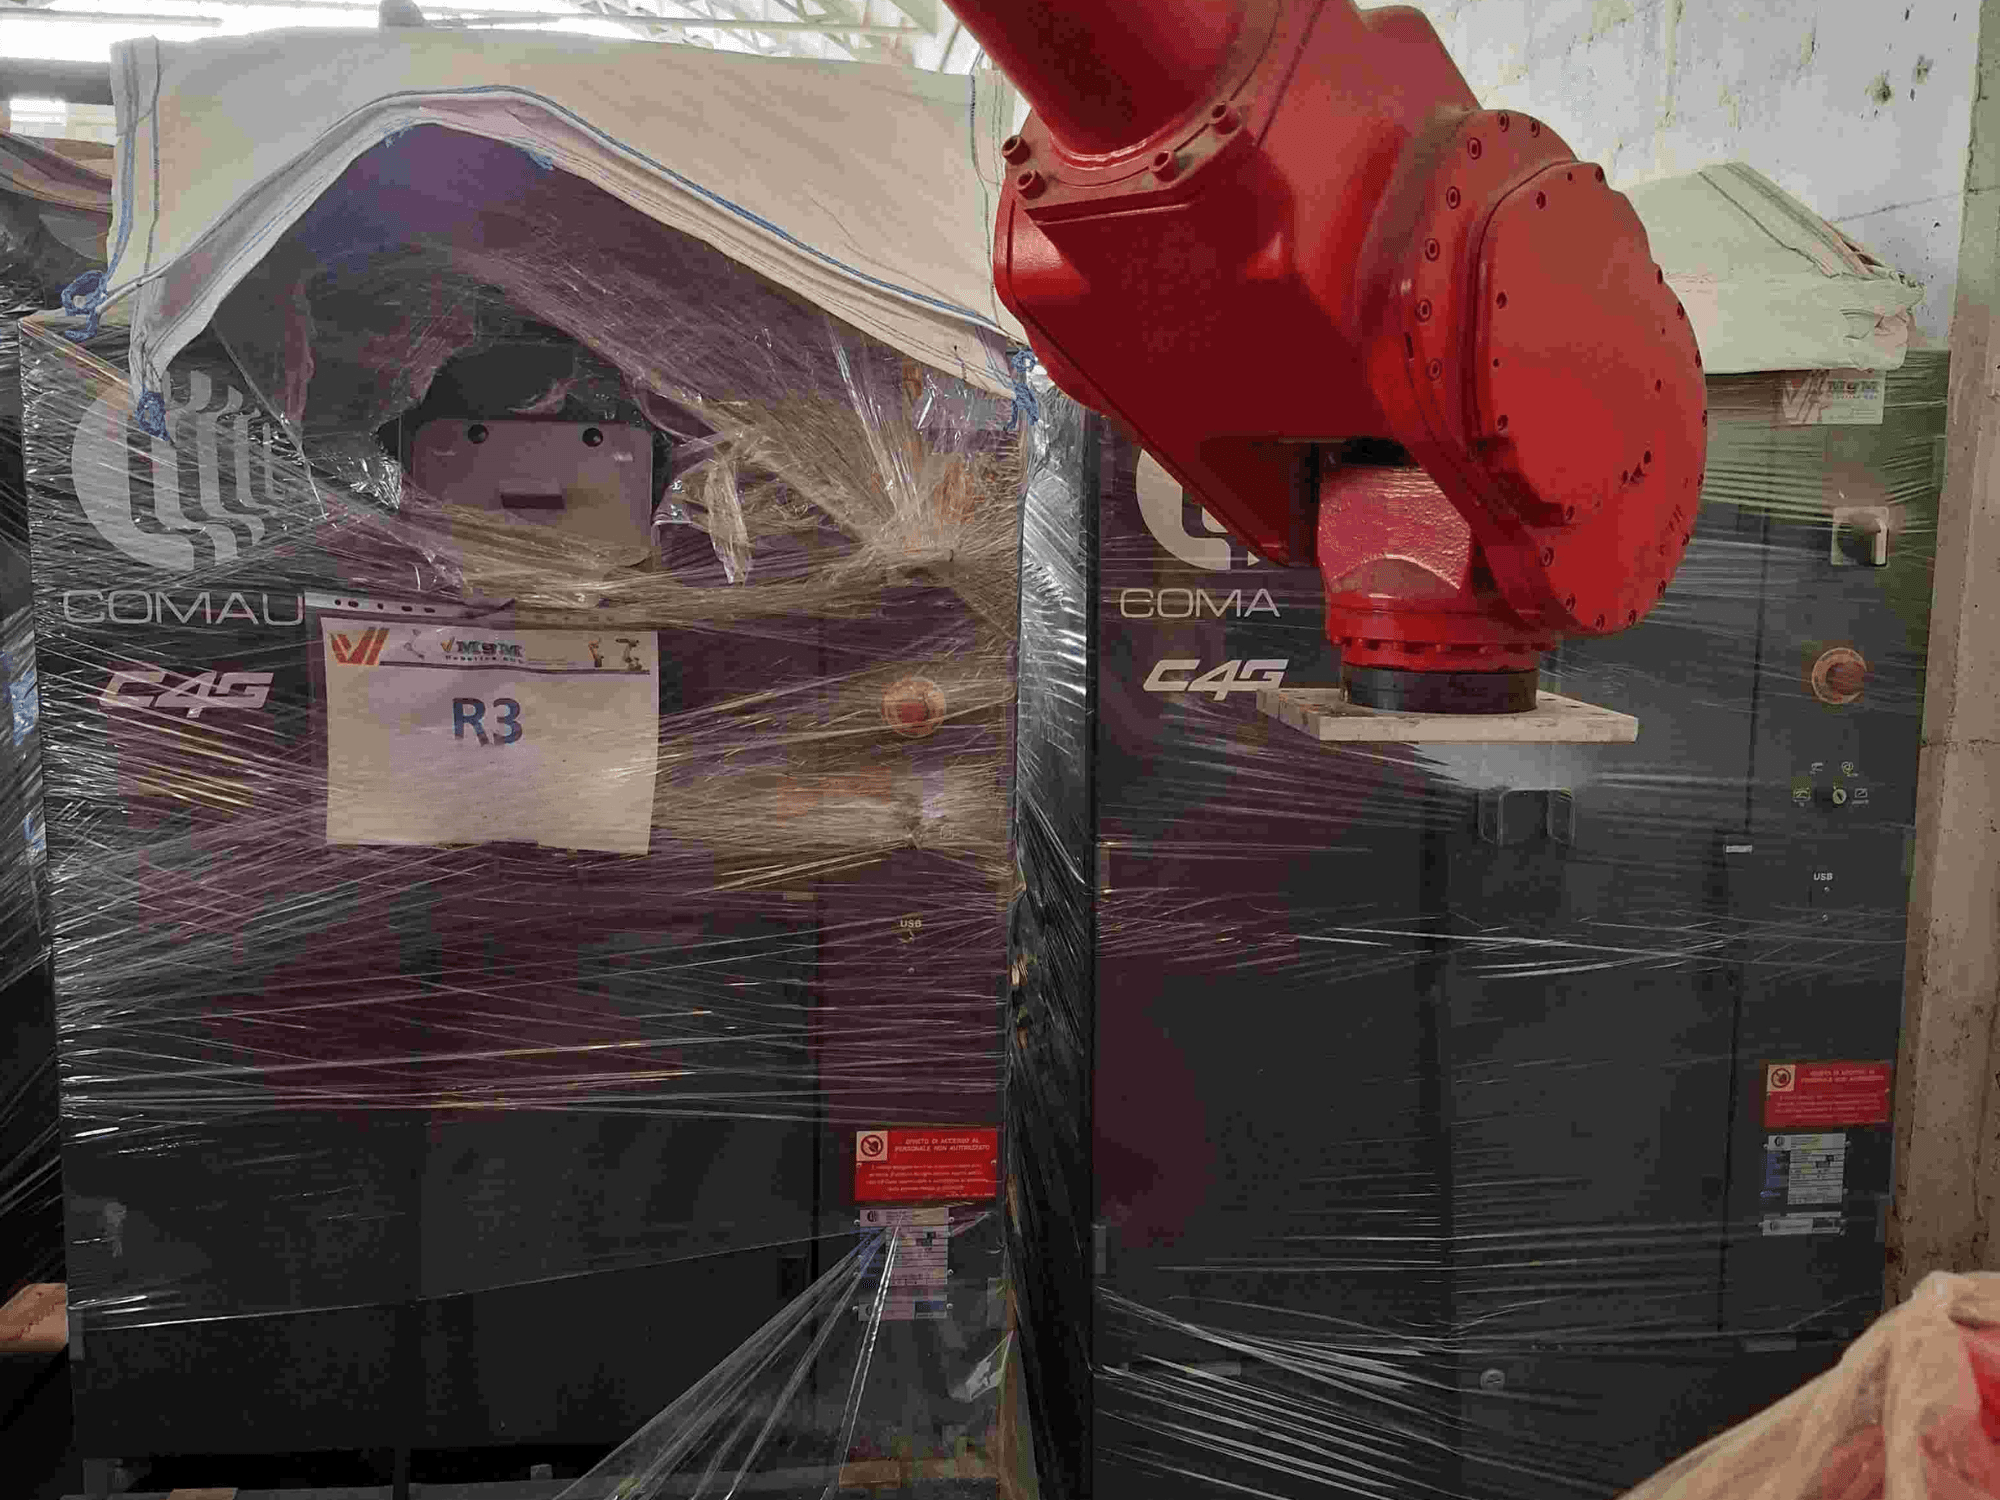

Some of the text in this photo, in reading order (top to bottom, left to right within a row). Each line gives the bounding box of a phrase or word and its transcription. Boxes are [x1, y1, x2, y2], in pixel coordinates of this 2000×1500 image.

[63, 589, 304, 626] COMAU
[1120, 588, 1281, 618] COMA
[100, 671, 274, 718] C4G
[1143, 659, 1289, 700] C4G
[452, 697, 523, 746] R3
[1813, 872, 1833, 881] USB
[900, 919, 922, 928] USB
